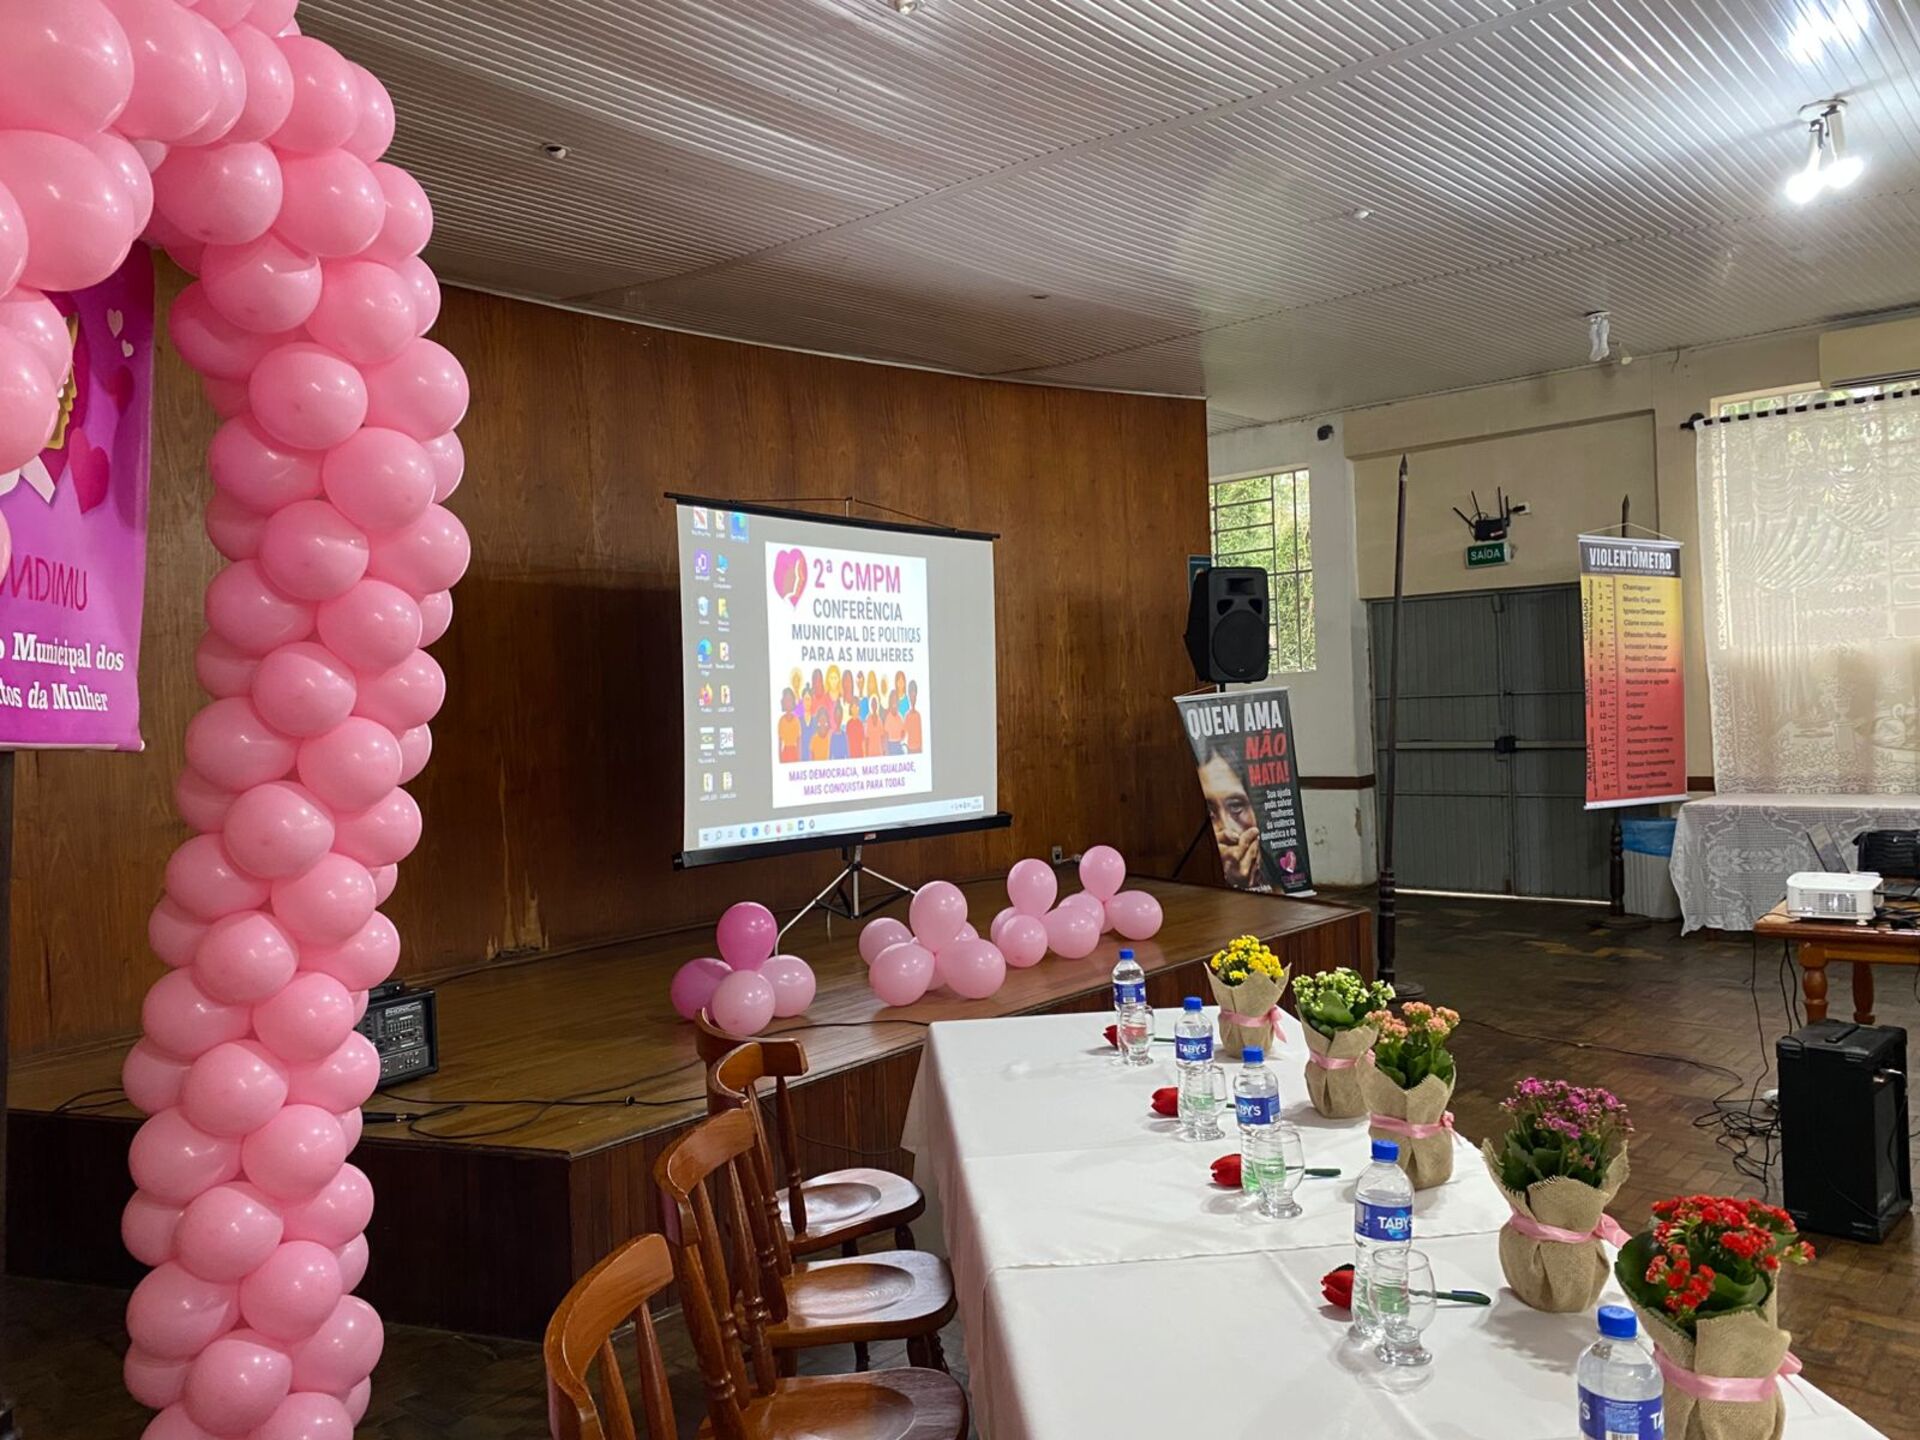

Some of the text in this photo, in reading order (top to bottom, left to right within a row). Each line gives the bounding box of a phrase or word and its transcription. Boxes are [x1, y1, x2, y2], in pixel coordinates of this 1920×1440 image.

[1470, 547, 1501, 561] SAÍDA
[1589, 546, 1672, 570] VIOLENTÔMETRO
[841, 561, 901, 593] CMPM
[813, 597, 903, 621] CONFERÊNCIA
[792, 624, 859, 642] MUNICIPAL
[862, 626, 876, 642] DE
[12, 632, 91, 674] Municipal
[96, 645, 125, 671] dos
[801, 646, 914, 663] PARA AS MULHERES
[0, 678, 109, 712] tos da Mulher
[1186, 700, 1283, 740] QUEM AMA
[1245, 729, 1286, 760] NÃO
[789, 769, 807, 781] MAIS
[809, 766, 860, 780] DEMOCRACIA,
[862, 764, 879, 776] MAIS
[1248, 760, 1290, 787] MATA!
[803, 776, 906, 795] MAIS CONQUISTA PARA TODAS
